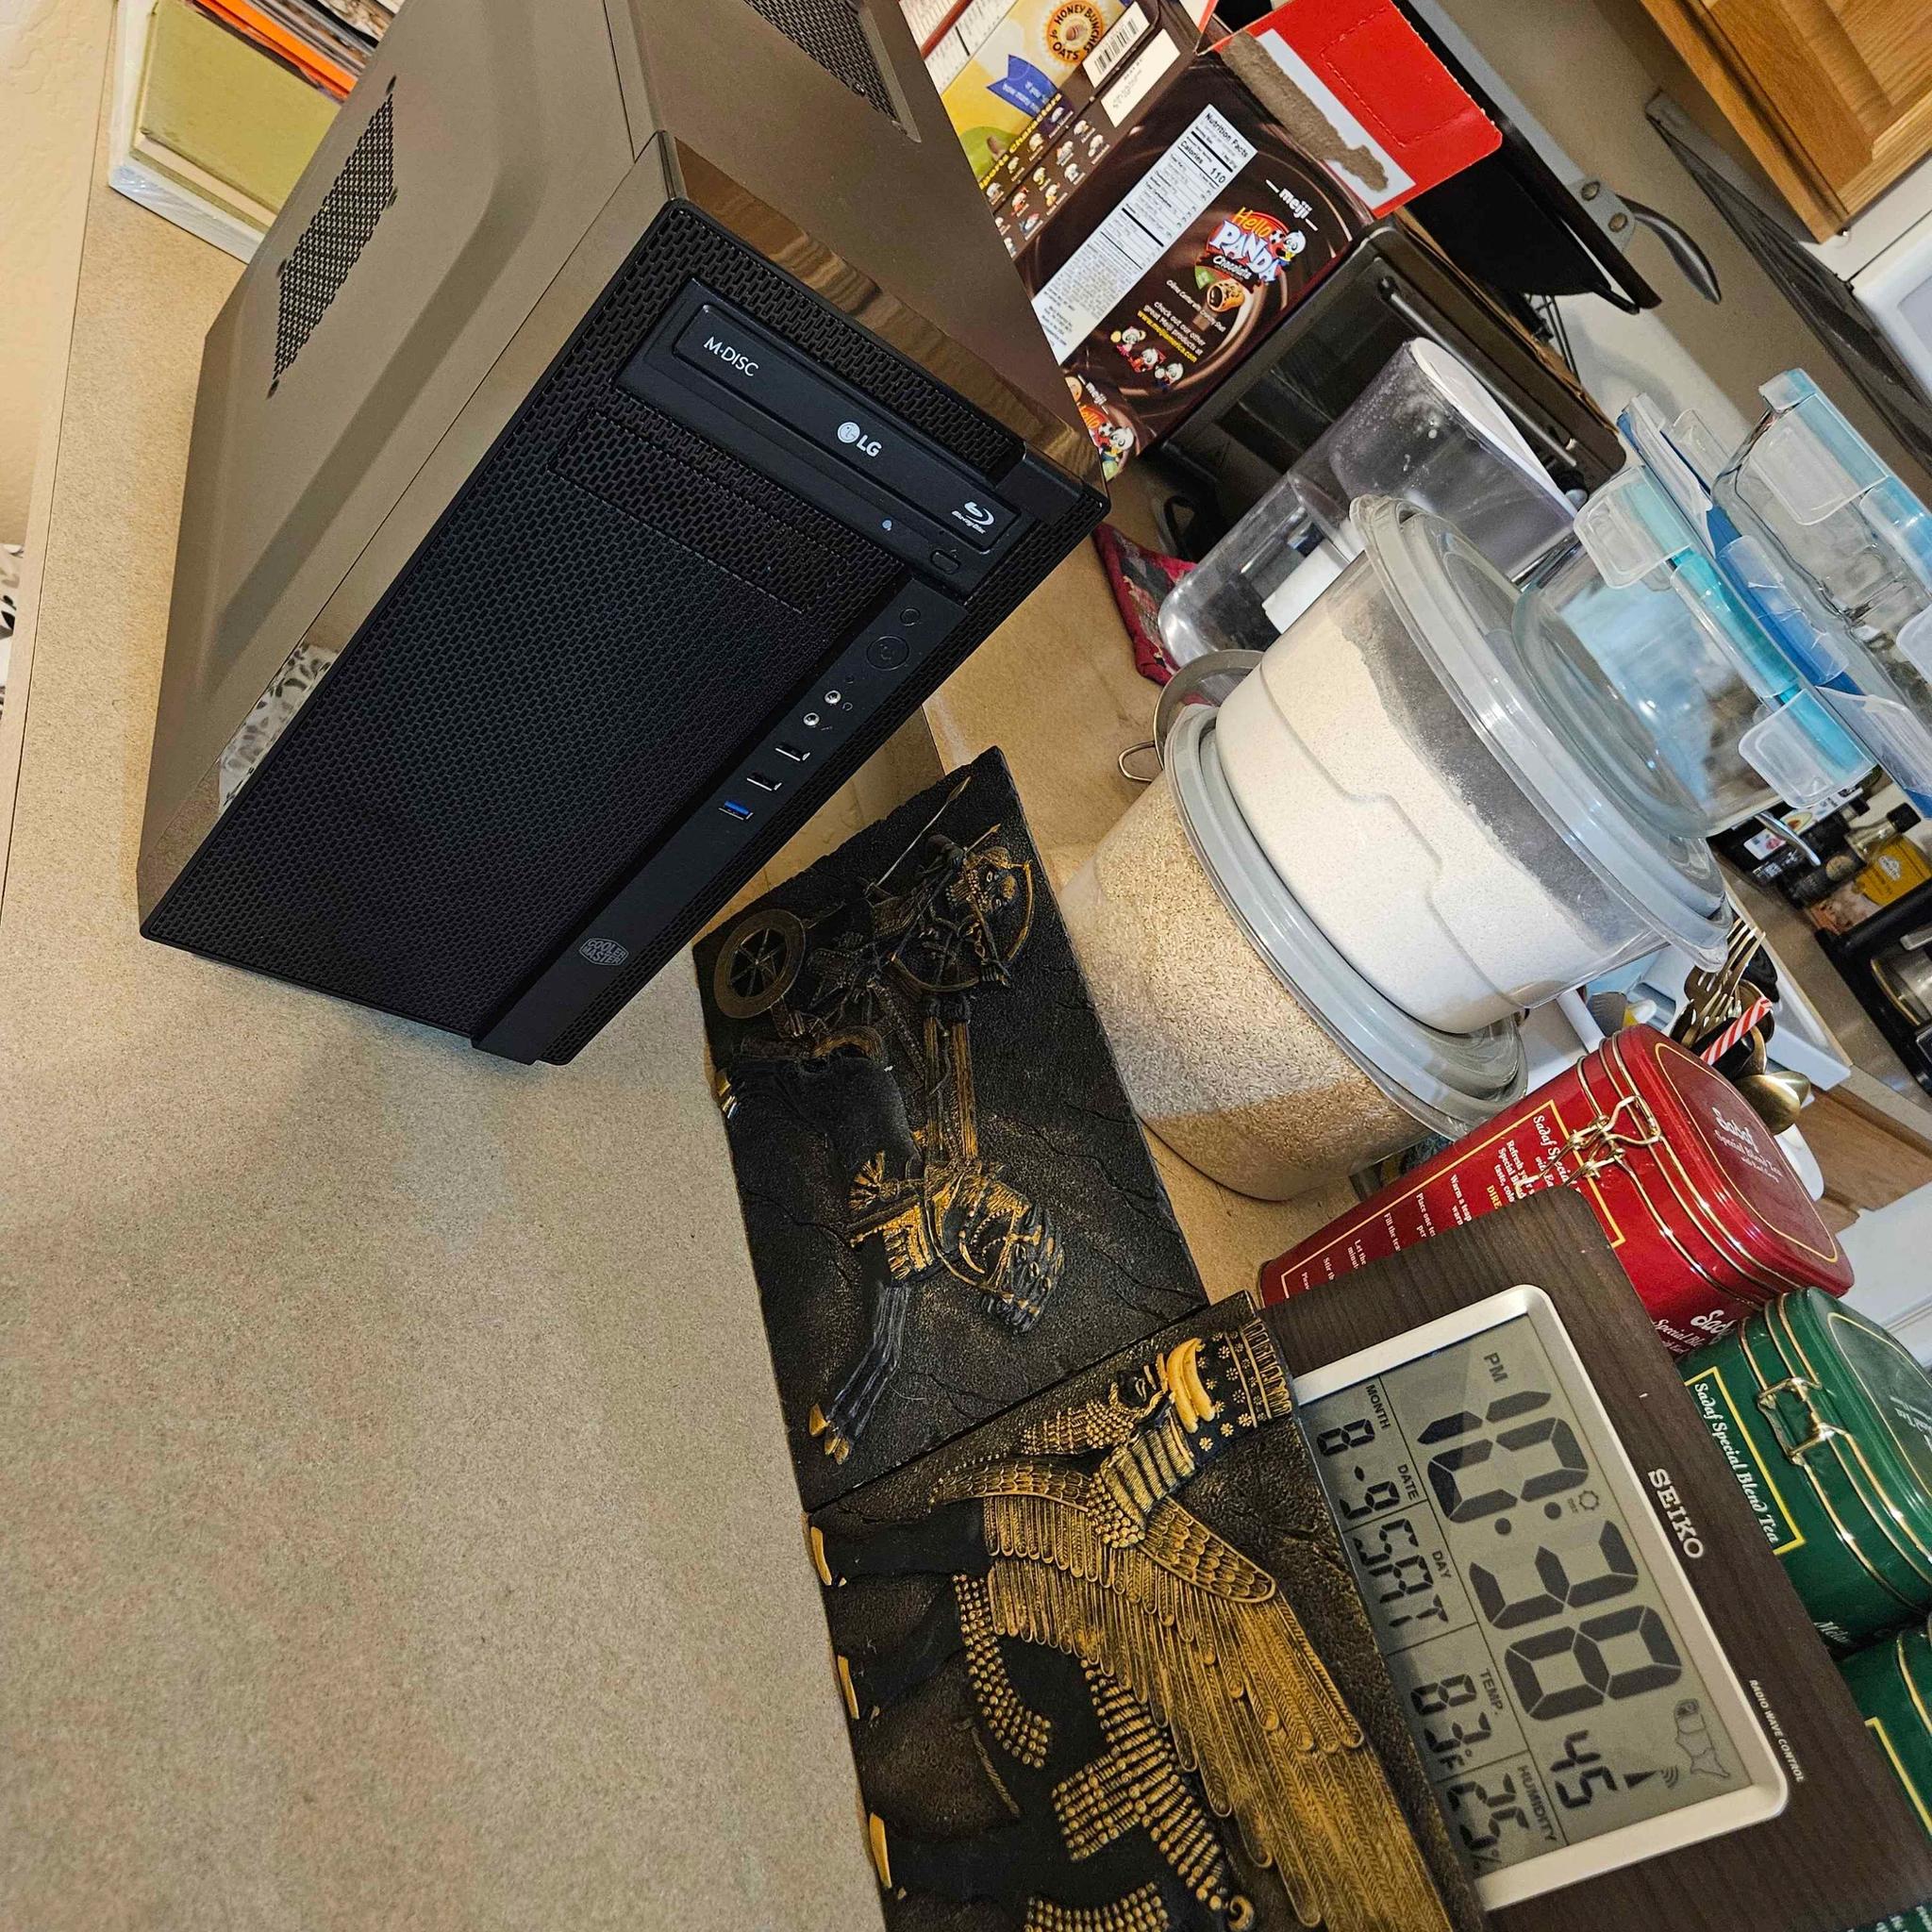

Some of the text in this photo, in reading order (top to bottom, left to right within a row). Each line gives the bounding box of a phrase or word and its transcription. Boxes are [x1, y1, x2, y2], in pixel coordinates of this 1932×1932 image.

[1056, 5, 1101, 53] HONEY BUNCHES
[1052, 42, 1079, 60] OATS
[1205, 112, 1232, 142] Nutrition
[1231, 139, 1249, 158] Facts
[1180, 141, 1204, 164] Calories
[1210, 168, 1226, 184] 110
[1278, 189, 1313, 220] meiji
[1232, 207, 1273, 238] Hello
[1209, 221, 1281, 282] PANDA
[1212, 255, 1254, 279] Chocolate
[1135, 308, 1198, 363] www.meijiamerica.com
[1141, 303, 1203, 356] great Meiji products at
[1169, 314, 1182, 327] out
[1178, 323, 1191, 335] our
[1188, 330, 1207, 347] other
[1086, 382, 1107, 405] meiji
[856, 433, 882, 458] LG
[583, 945, 624, 964] MASTER
[587, 937, 626, 958] COOLER
[1532, 1114, 1553, 1149] Sadaf
[1492, 1163, 1508, 1186] taste,
[1495, 1147, 1515, 1175] Special
[1505, 1140, 1525, 1170] Refresh
[1518, 1170, 1534, 1191] yor
[1413, 1191, 1430, 1213] Place
[1447, 1174, 1466, 1199] Warm
[1458, 1203, 1474, 1223] teap
[1382, 1212, 1403, 1252] Fill the tea
[1415, 1224, 1427, 1239] per
[1421, 1212, 1432, 1226] one
[1320, 1256, 1334, 1272] Stir
[1343, 1245, 1362, 1270] minut
[1352, 1239, 1369, 1266] Let the
[1655, 1319, 1694, 1340] Special
[1483, 1351, 1509, 1385] PM
[1694, 1383, 1780, 1544] Sadaf Special Blend Tea
[1648, 1466, 1705, 1561] SEIKO
[1418, 1390, 1683, 1722] 10:38
[1353, 1517, 1448, 1629] SAT
[1364, 1385, 1391, 1431] MONTH
[1396, 1463, 1421, 1504] DATE
[1430, 1550, 1452, 1580] DAY
[1517, 1765, 1557, 1843] HUMIDITY
[1747, 1677, 1806, 1783] RADIO WAVE CONTROL
[1550, 1729, 1619, 1810] 45
